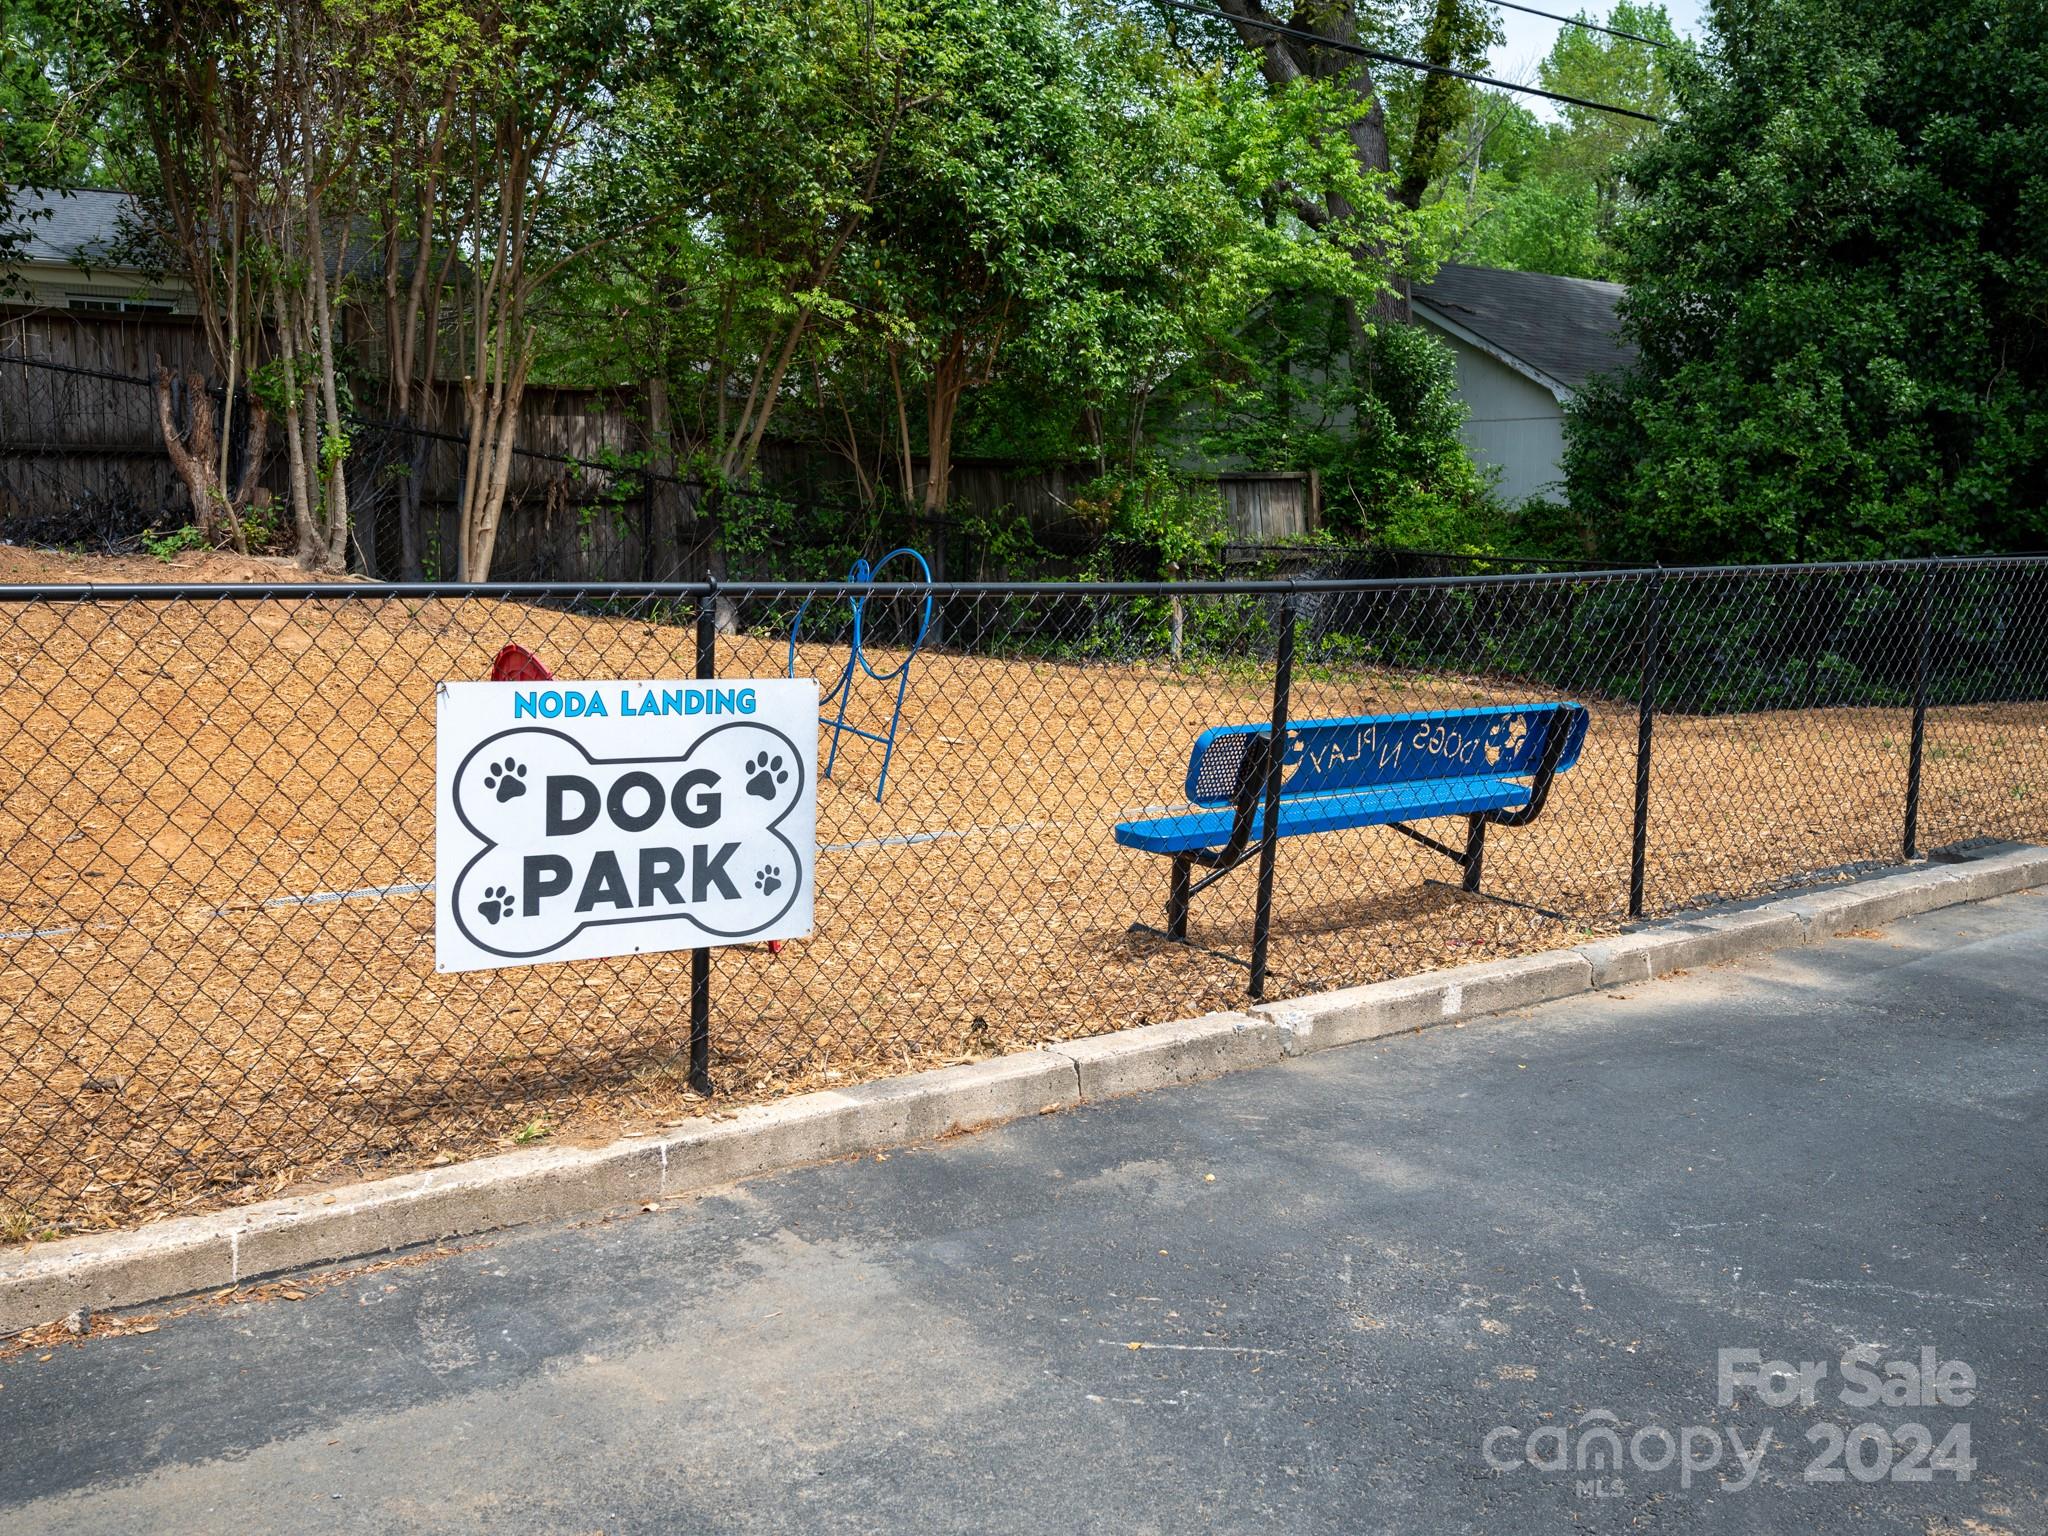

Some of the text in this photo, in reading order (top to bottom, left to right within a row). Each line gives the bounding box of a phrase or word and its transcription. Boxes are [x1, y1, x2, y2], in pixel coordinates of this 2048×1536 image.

[514, 688, 757, 719] NODA LANDING
[545, 768, 722, 837] DOG
[522, 842, 742, 918] PARK
